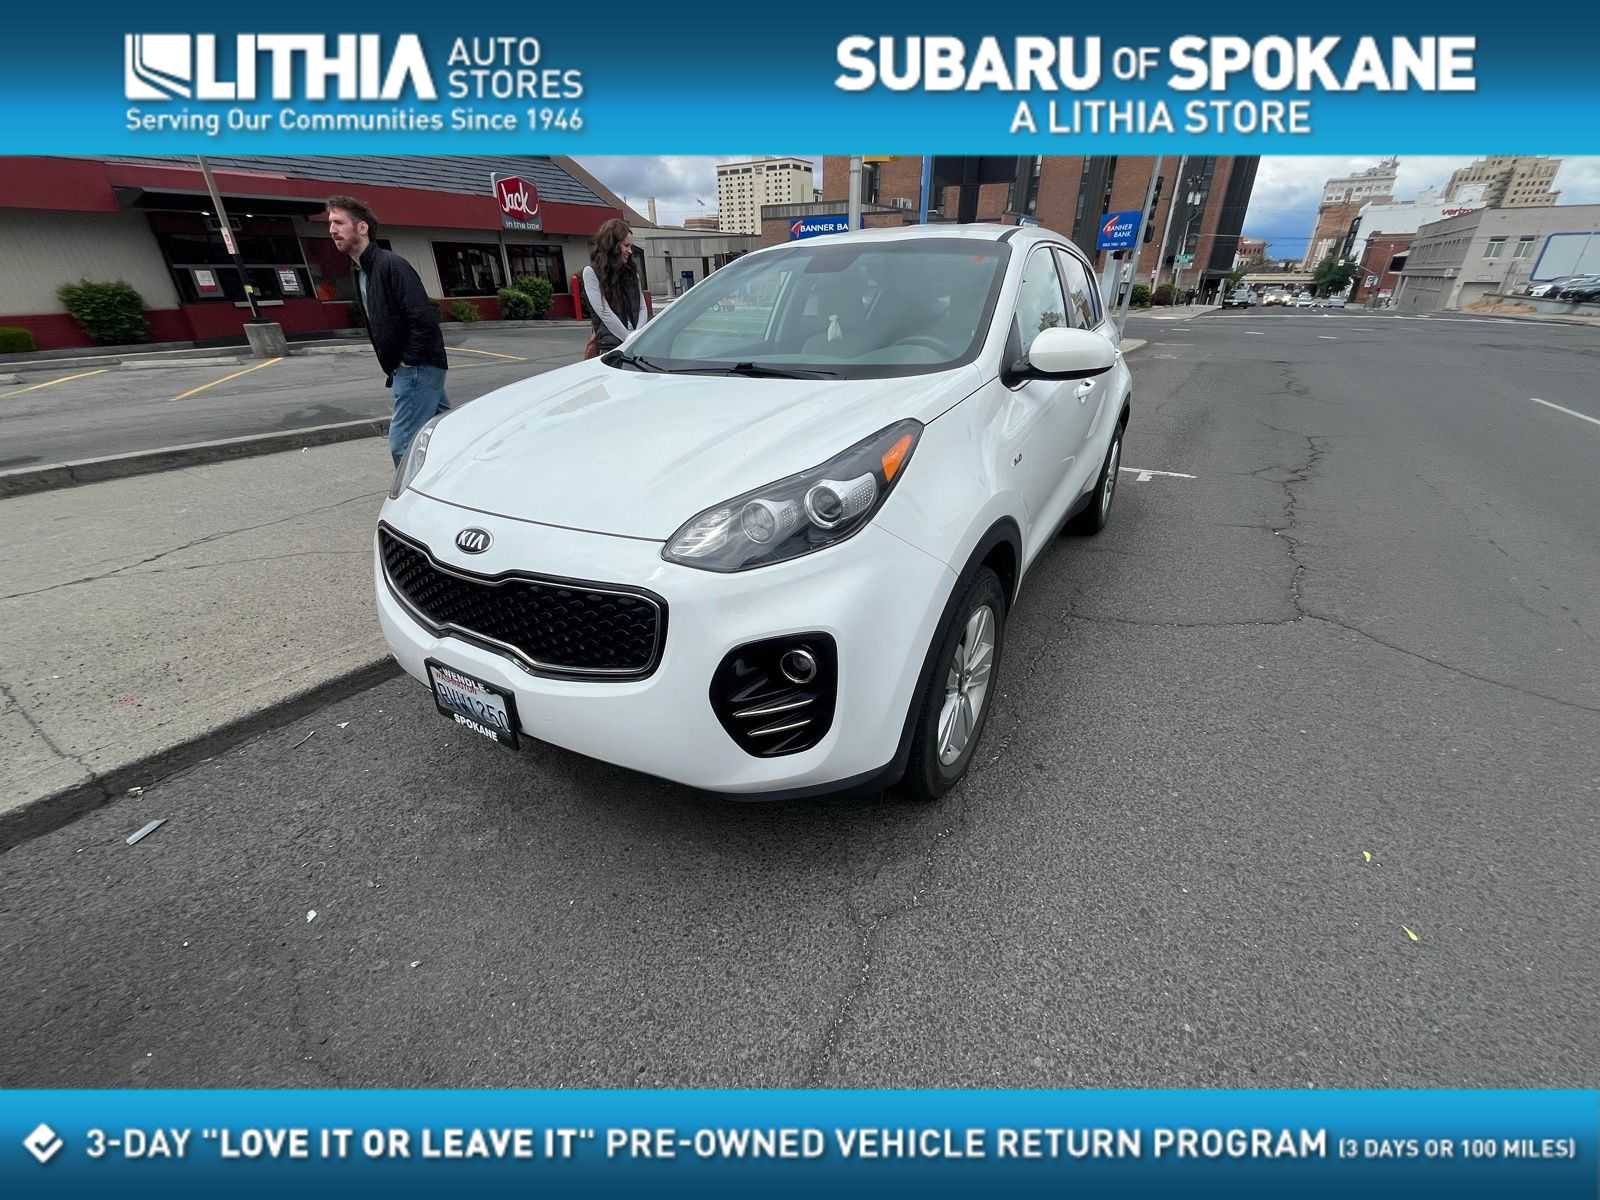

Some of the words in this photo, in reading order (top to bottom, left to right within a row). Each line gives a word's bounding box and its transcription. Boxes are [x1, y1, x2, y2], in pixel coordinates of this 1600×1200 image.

[500, 182, 538, 215] Jack
[800, 223, 834, 233] BANNER
[1107, 223, 1133, 232] BANNER
[458, 530, 485, 550] KIA
[453, 712, 499, 742] SPOKANE
